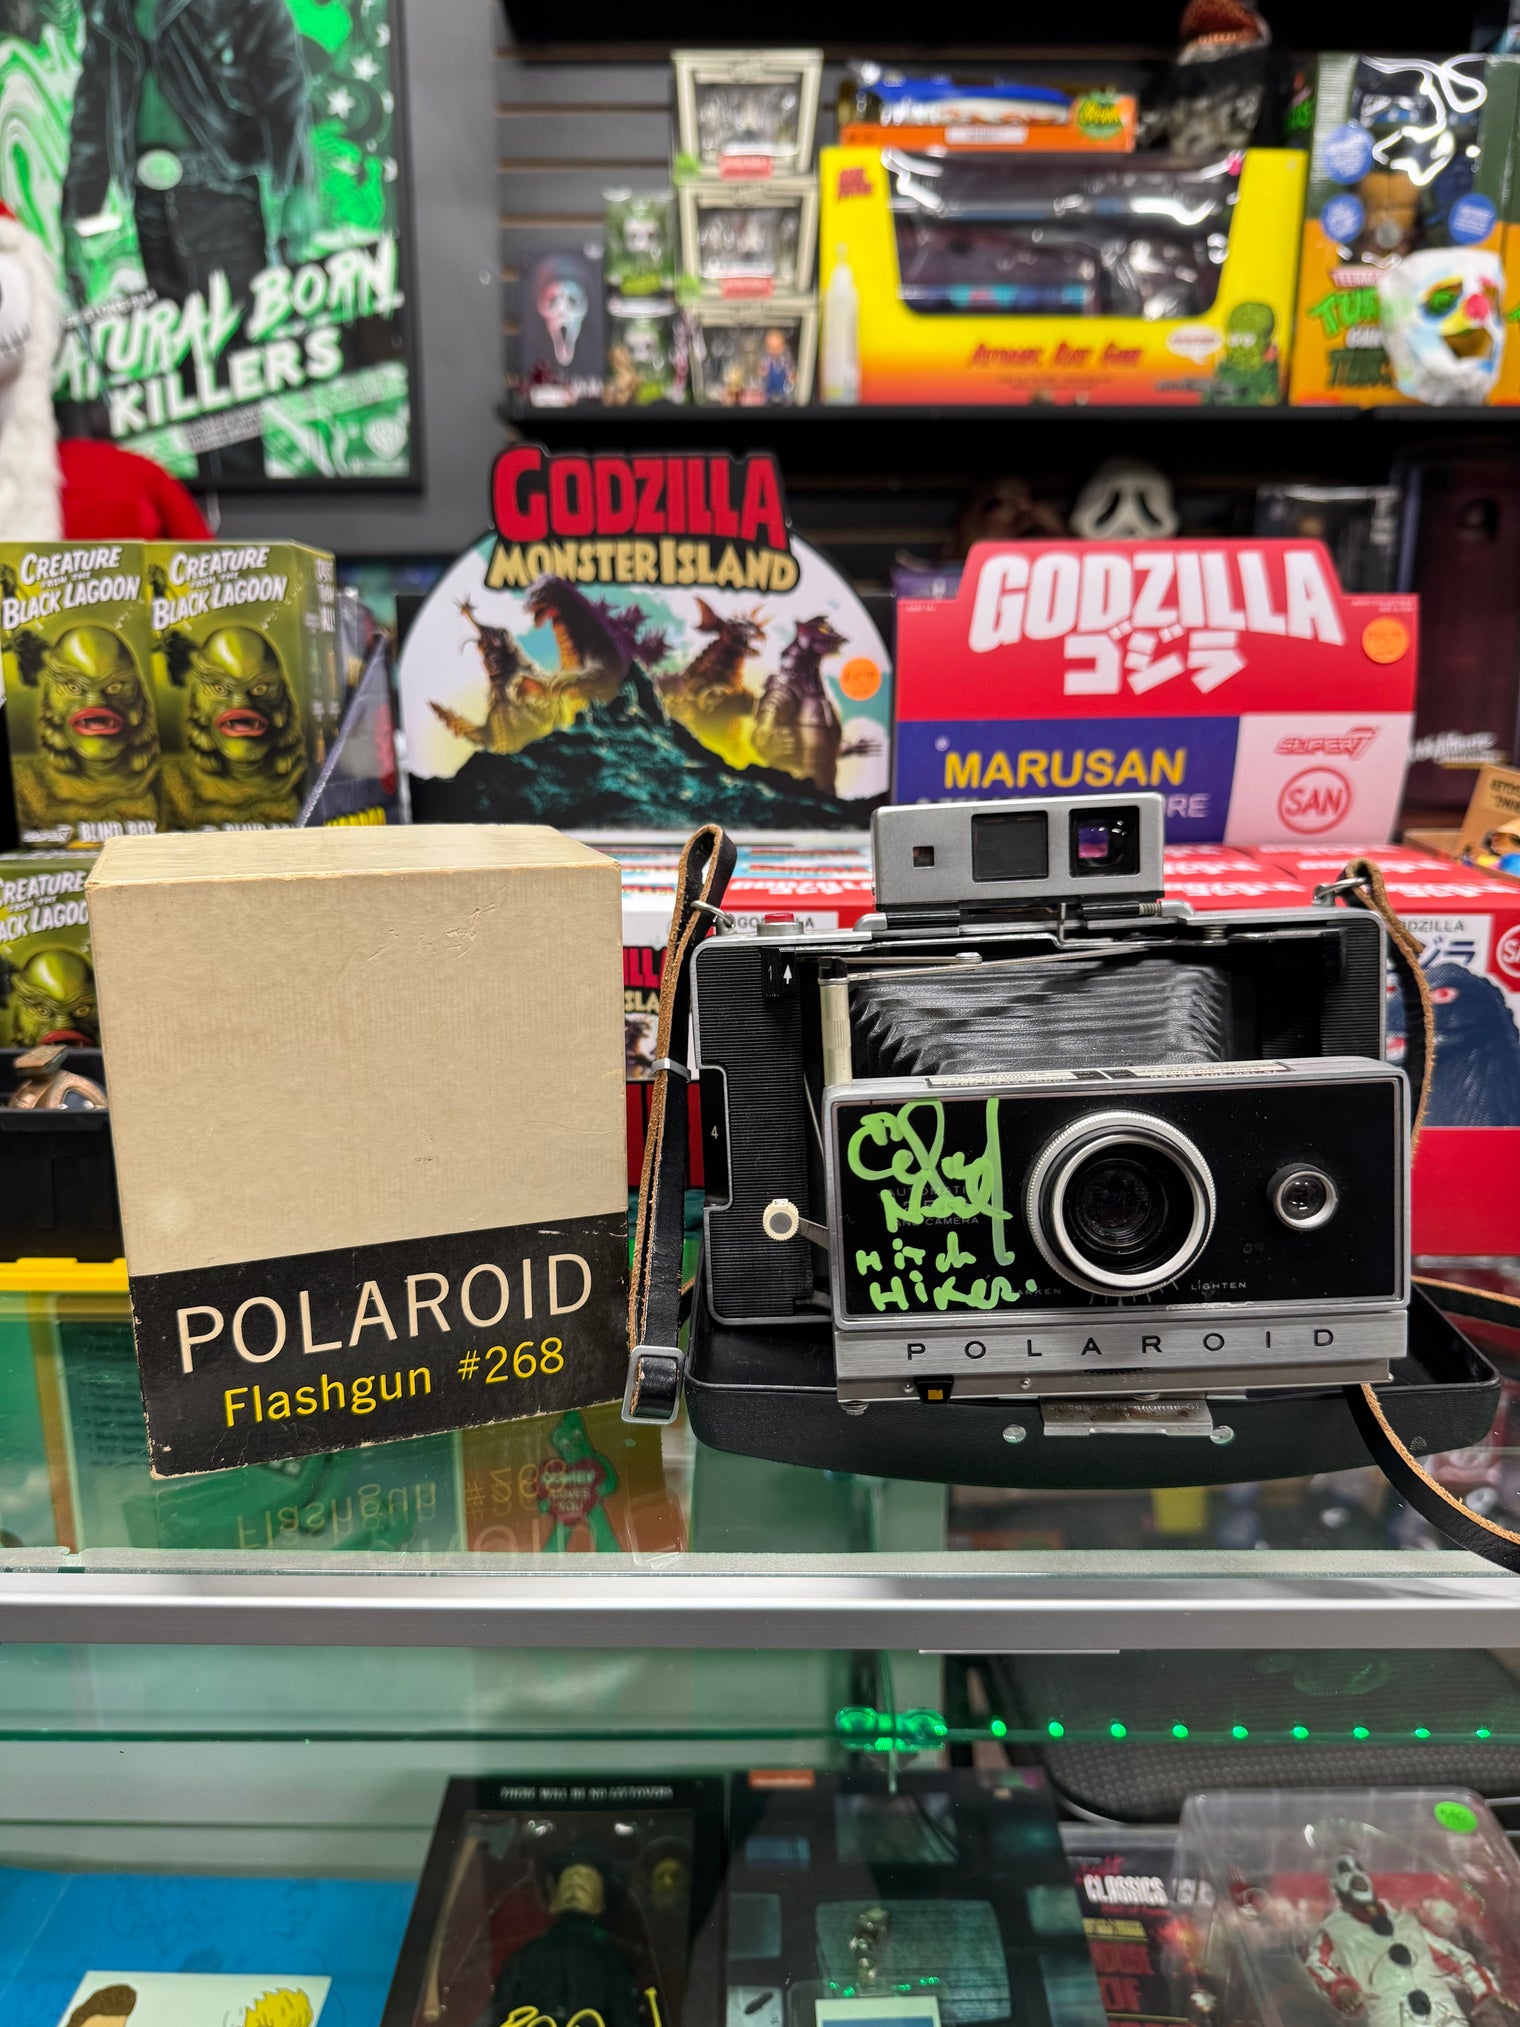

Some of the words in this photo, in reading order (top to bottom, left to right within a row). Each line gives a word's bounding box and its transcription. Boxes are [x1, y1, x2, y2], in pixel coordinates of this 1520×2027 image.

[45, 266, 246, 402] ATURAL
[246, 231, 405, 342] BORN
[110, 324, 344, 440] KILLERS
[493, 445, 788, 552] GODZILLA
[20, 545, 123, 586] CREATURE
[170, 545, 271, 586] CREATURE
[485, 538, 660, 588] MONSTER
[660, 535, 800, 592] ISLAND
[2, 589, 62, 630] BLACK
[63, 576, 141, 609] LAGOON
[152, 589, 210, 630] BLACK
[211, 576, 288, 609] LAGOON
[967, 550, 1346, 653] GODZILLA
[1062, 620, 1247, 695] ゴジラ
[944, 747, 1186, 790] MARUSAN
[1285, 786, 1342, 817] SAN
[710, 1125, 719, 1140] 4
[1190, 1280, 1247, 1291] LIGHTEN
[175, 1252, 593, 1375] POLAROID
[906, 1328, 1335, 1361] POLAROID
[224, 1365, 432, 1429] Flashgun
[456, 1336, 566, 1386] #268
[1083, 1873, 1169, 1907] CLASSICS
